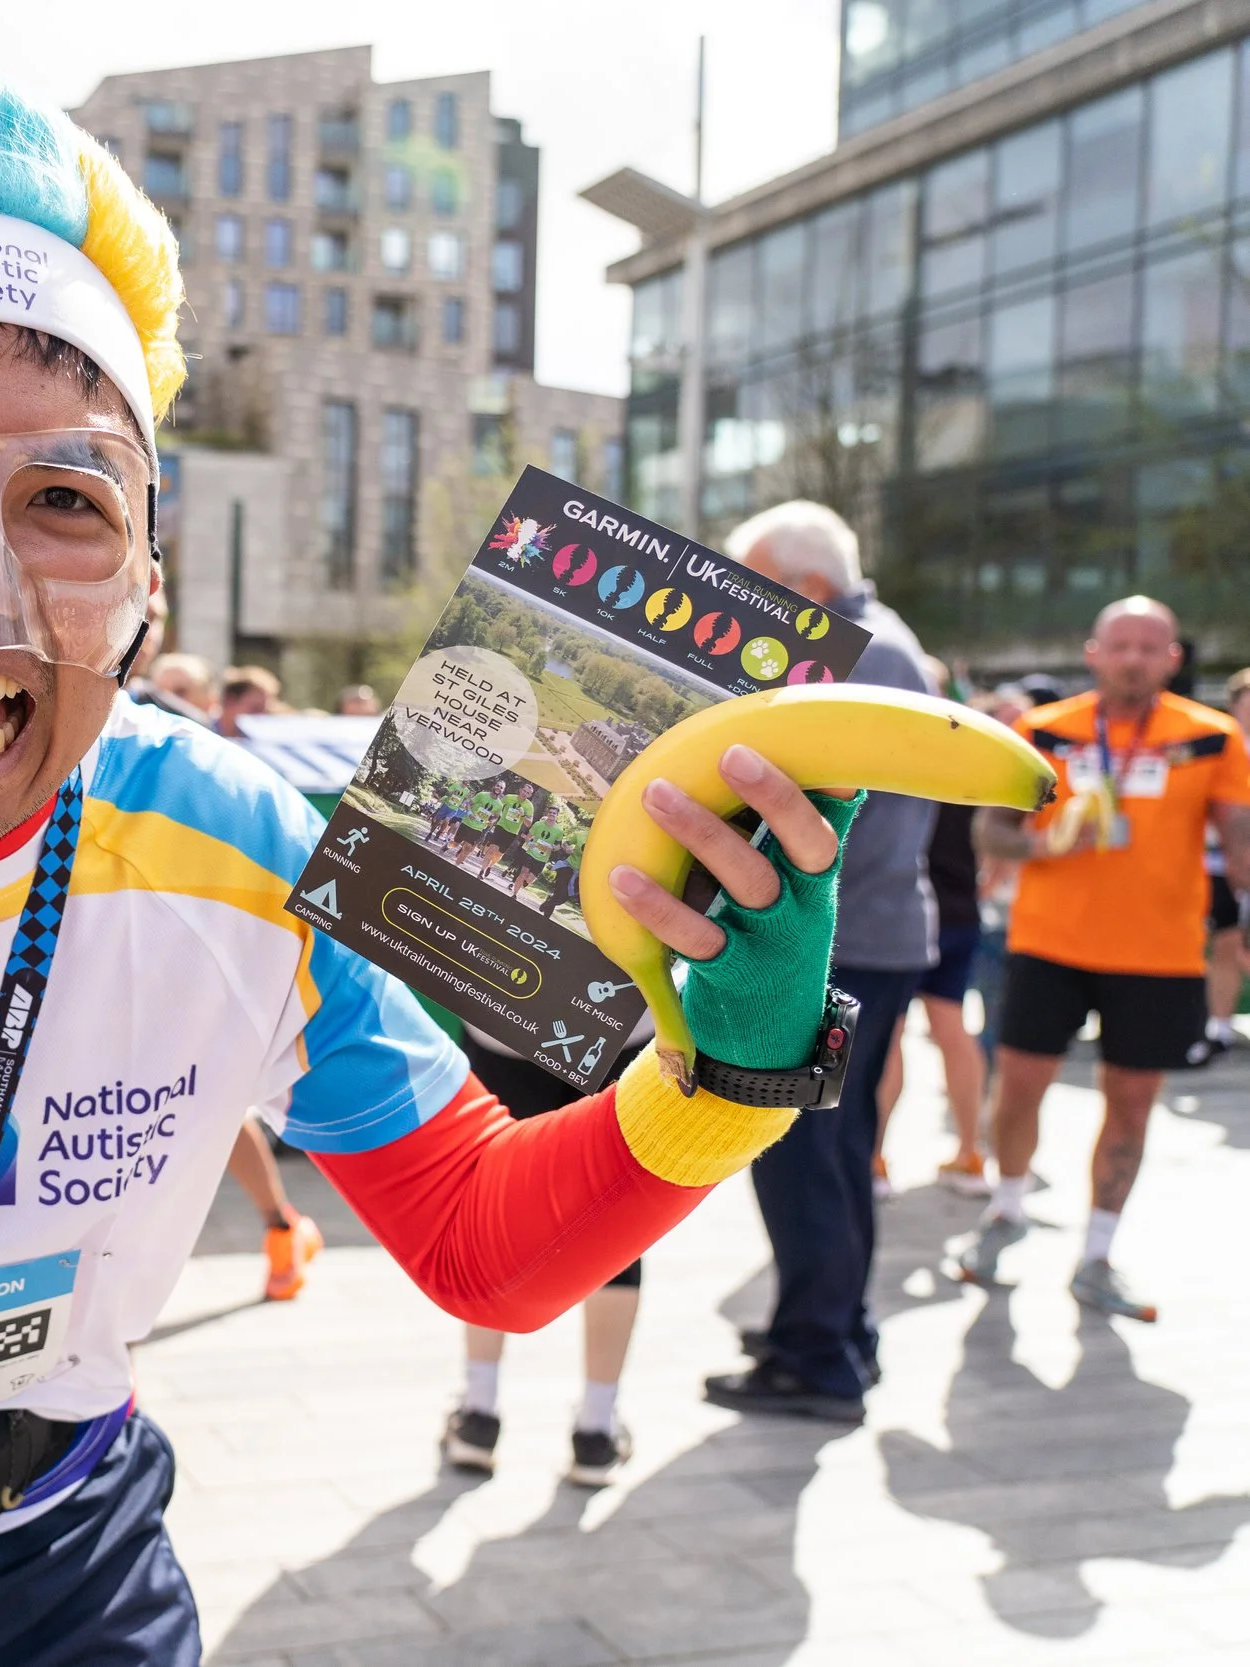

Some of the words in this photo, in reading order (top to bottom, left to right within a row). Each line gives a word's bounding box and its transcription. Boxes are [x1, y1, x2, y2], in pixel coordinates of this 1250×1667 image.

[498, 561, 515, 572] 2M
[686, 554, 727, 588] UK
[726, 571, 751, 589] TRAIL
[753, 585, 799, 613] RUNNING
[552, 586, 567, 597] 5K
[719, 579, 791, 625] FESTIVAL
[597, 608, 615, 620] 10K
[637, 628, 667, 645] HALF
[687, 653, 714, 670] FULL
[432, 673, 459, 690] ST
[462, 689, 519, 723] GILES
[440, 660, 493, 692] HELD
[497, 691, 526, 708] AT
[726, 684, 750, 696] +DO
[736, 678, 760, 693] RUN
[433, 707, 487, 741] NEAR
[434, 690, 502, 731] HOUSE
[406, 707, 503, 765] VERWOOD
[323, 847, 361, 874] RUNNING
[294, 904, 332, 931] CAMPING
[400, 864, 454, 901] APRIL
[458, 897, 506, 925] 28TH
[506, 924, 561, 960] 2024
[397, 903, 433, 929] SIGN
[435, 927, 457, 942] UP
[461, 939, 480, 958] UK
[361, 920, 540, 1035] www.uktrailrunningfestival.co.uk
[476, 951, 509, 977] FESTIVAL
[1, 983, 34, 1049] ABP
[570, 996, 593, 1013] LIVE
[591, 1008, 624, 1031] MUSIC
[533, 1050, 562, 1071] FOOD
[568, 1071, 589, 1086] BEV
[42, 1064, 197, 1125] National
